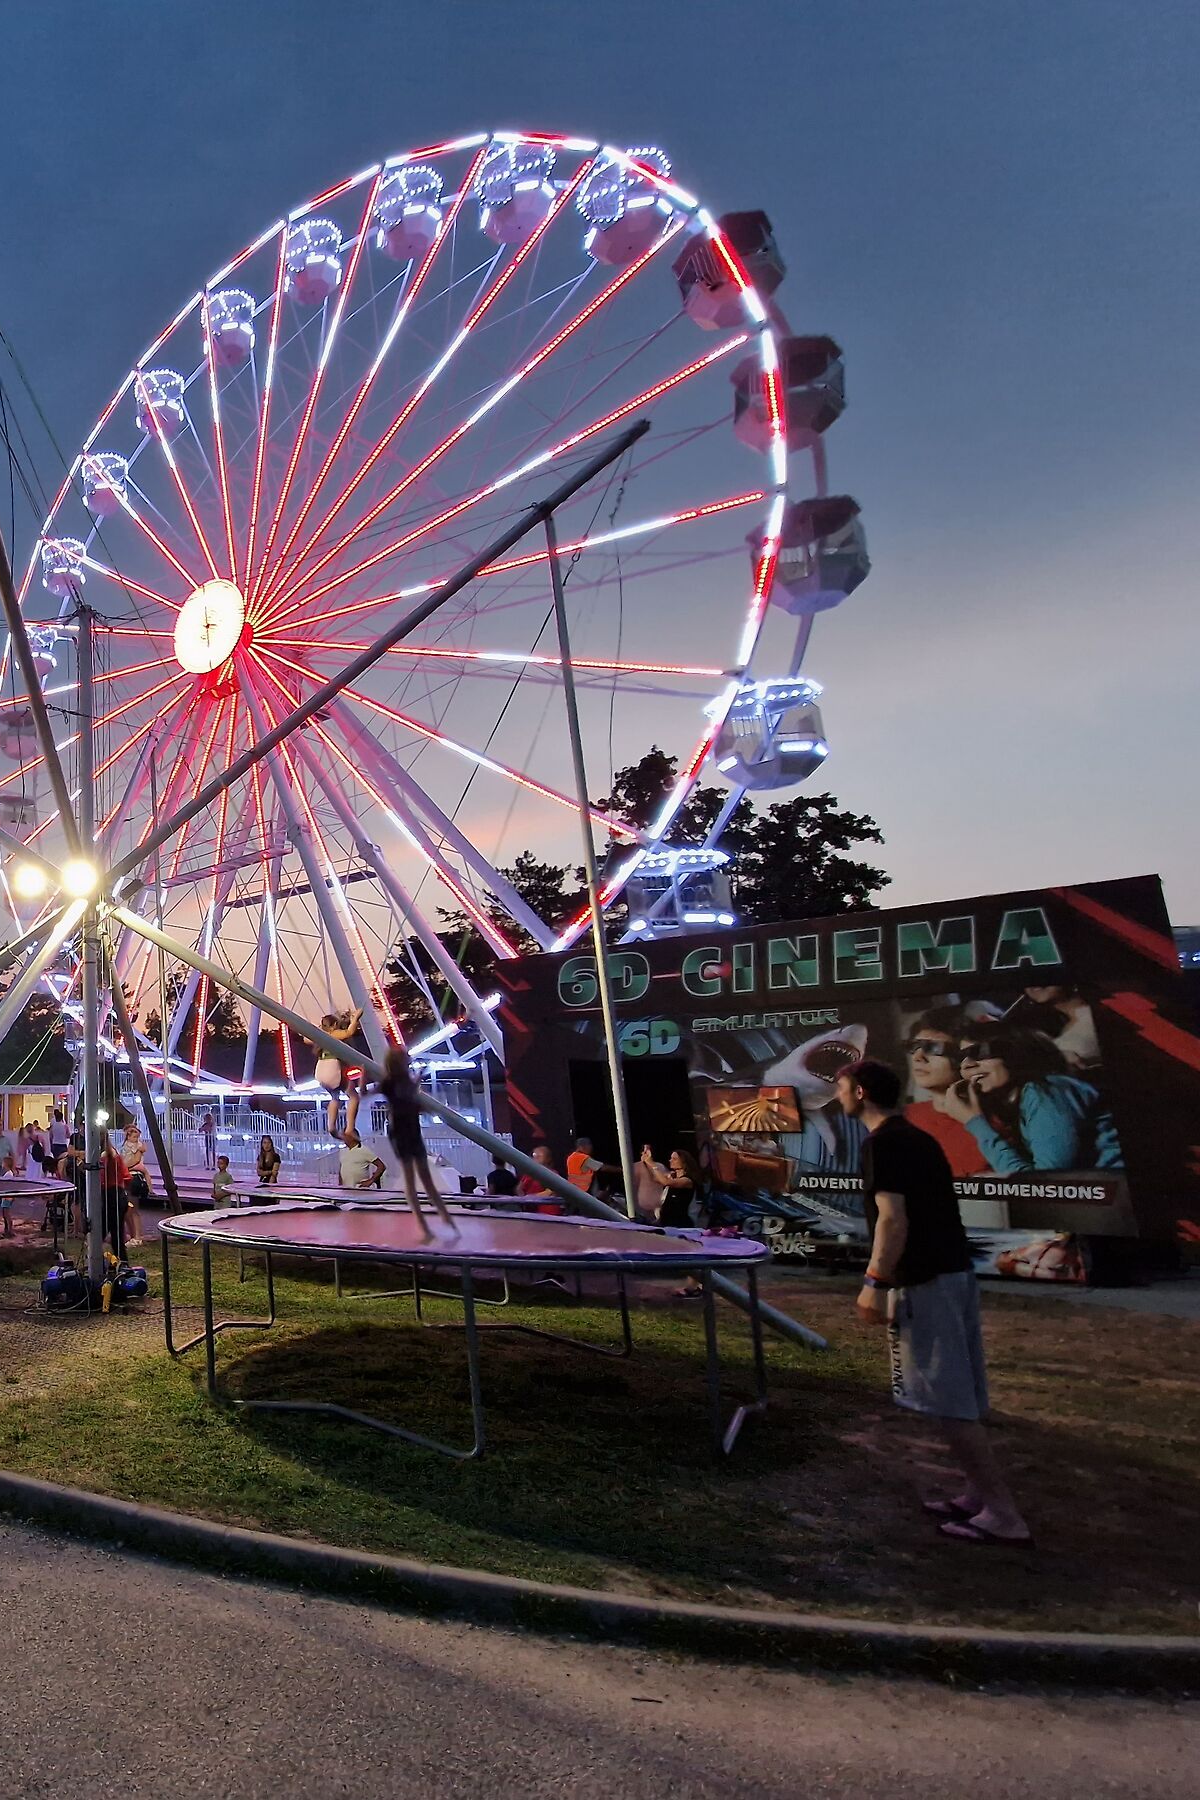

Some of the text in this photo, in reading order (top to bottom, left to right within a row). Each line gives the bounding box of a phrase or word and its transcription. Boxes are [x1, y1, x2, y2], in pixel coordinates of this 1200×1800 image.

[558, 907, 1062, 1006] 6D CINEMA
[619, 1008, 840, 1057] 6D SIMULATOR
[952, 1182, 980, 1195] EW
[984, 1182, 1106, 1200] DIMENSIONS
